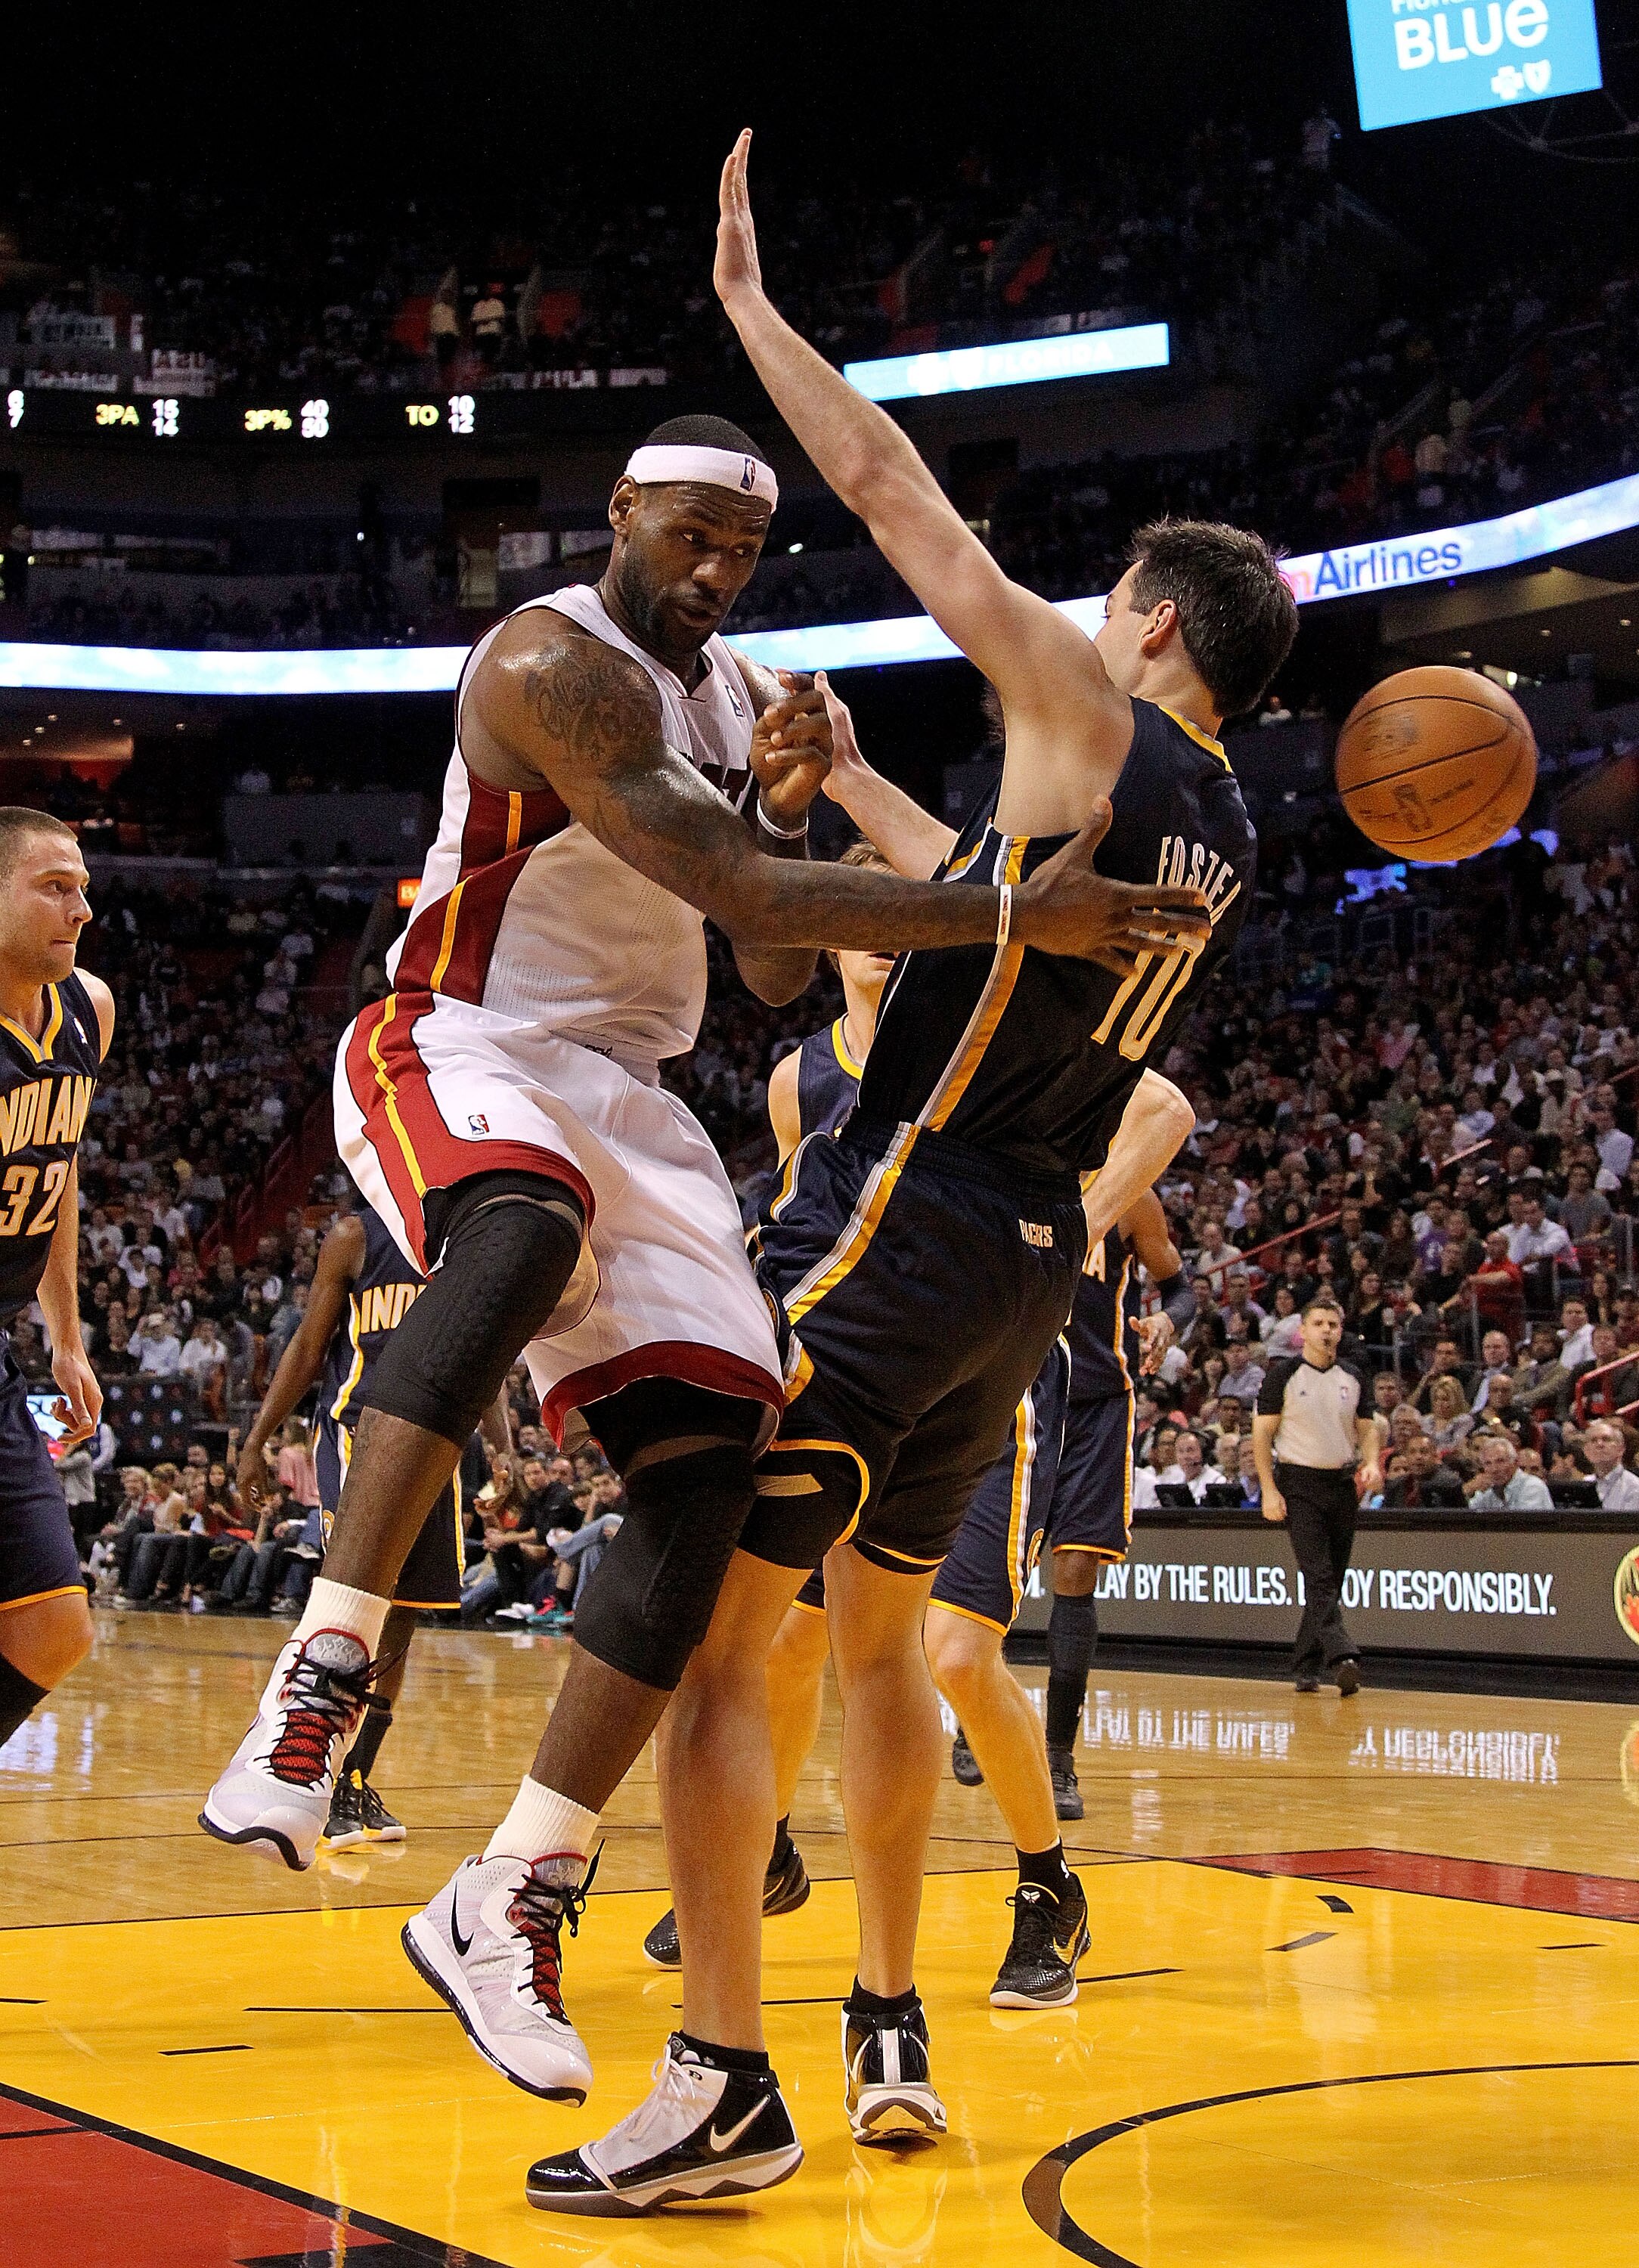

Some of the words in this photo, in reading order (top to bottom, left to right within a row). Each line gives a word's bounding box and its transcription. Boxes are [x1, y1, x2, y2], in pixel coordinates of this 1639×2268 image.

[987, 340, 1114, 376] FLORIDA
[95, 404, 141, 426] 3PA
[405, 404, 439, 426] TO
[448, 395, 476, 415] 10
[448, 414, 475, 434] 12
[0, 1075, 98, 1157] NDIAN
[0, 1160, 69, 1236] 32
[1018, 1218, 1053, 1247] PACRS
[361, 1283, 428, 1334] IND
[1093, 1563, 1131, 1600] LAY
[1134, 1563, 1163, 1601] BY
[1164, 1563, 1210, 1603] THE
[1213, 1565, 1293, 1606] RULES.
[1379, 1568, 1558, 1616] RESPONSIBLY.
